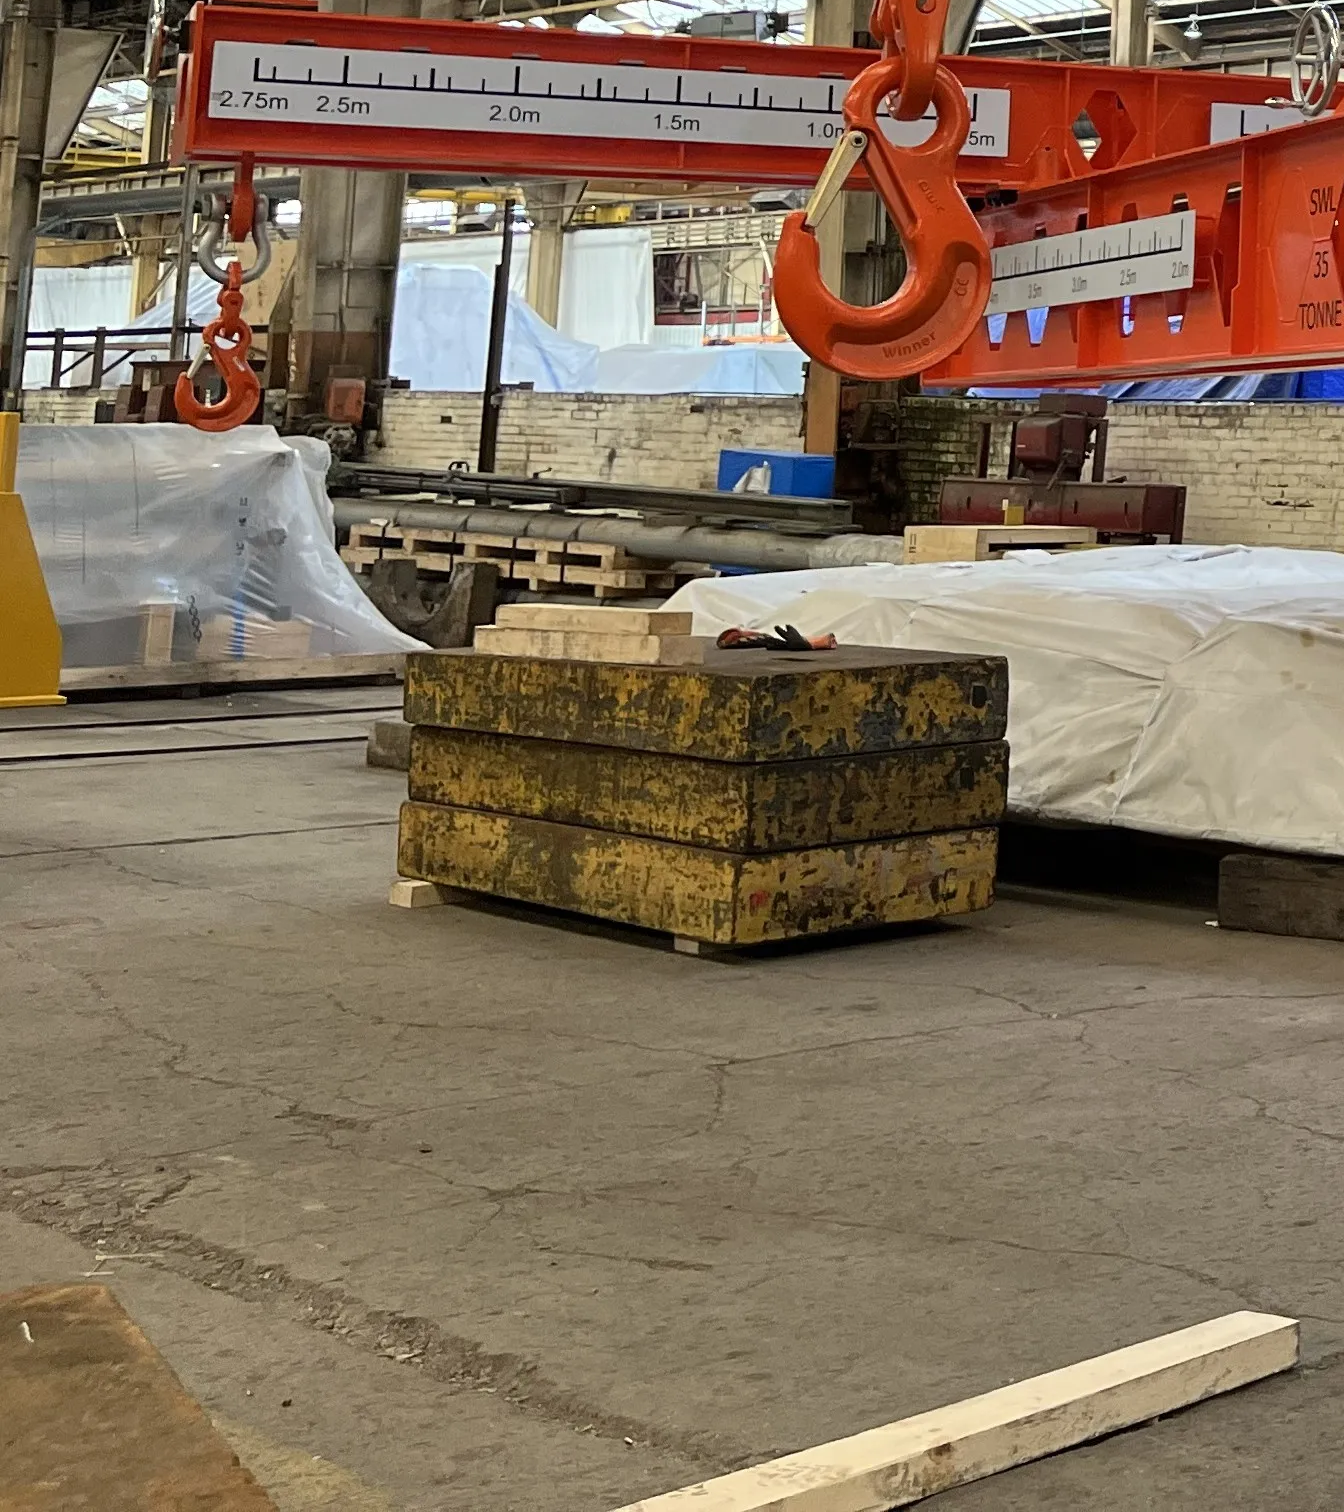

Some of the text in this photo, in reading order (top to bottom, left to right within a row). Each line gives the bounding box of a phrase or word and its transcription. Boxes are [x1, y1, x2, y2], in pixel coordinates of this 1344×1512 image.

[219, 90, 289, 110] 2.75m
[316, 95, 370, 115] 2.5m
[489, 104, 540, 123] 2.0m
[654, 113, 700, 132] 1.5m
[1310, 186, 1337, 216] SWL
[1120, 268, 1137, 287] 2.5m
[1172, 260, 1189, 279] 2.0m
[1313, 251, 1329, 279] 35
[1299, 300, 1343, 330] TONNE
[881, 331, 937, 359] Winner
